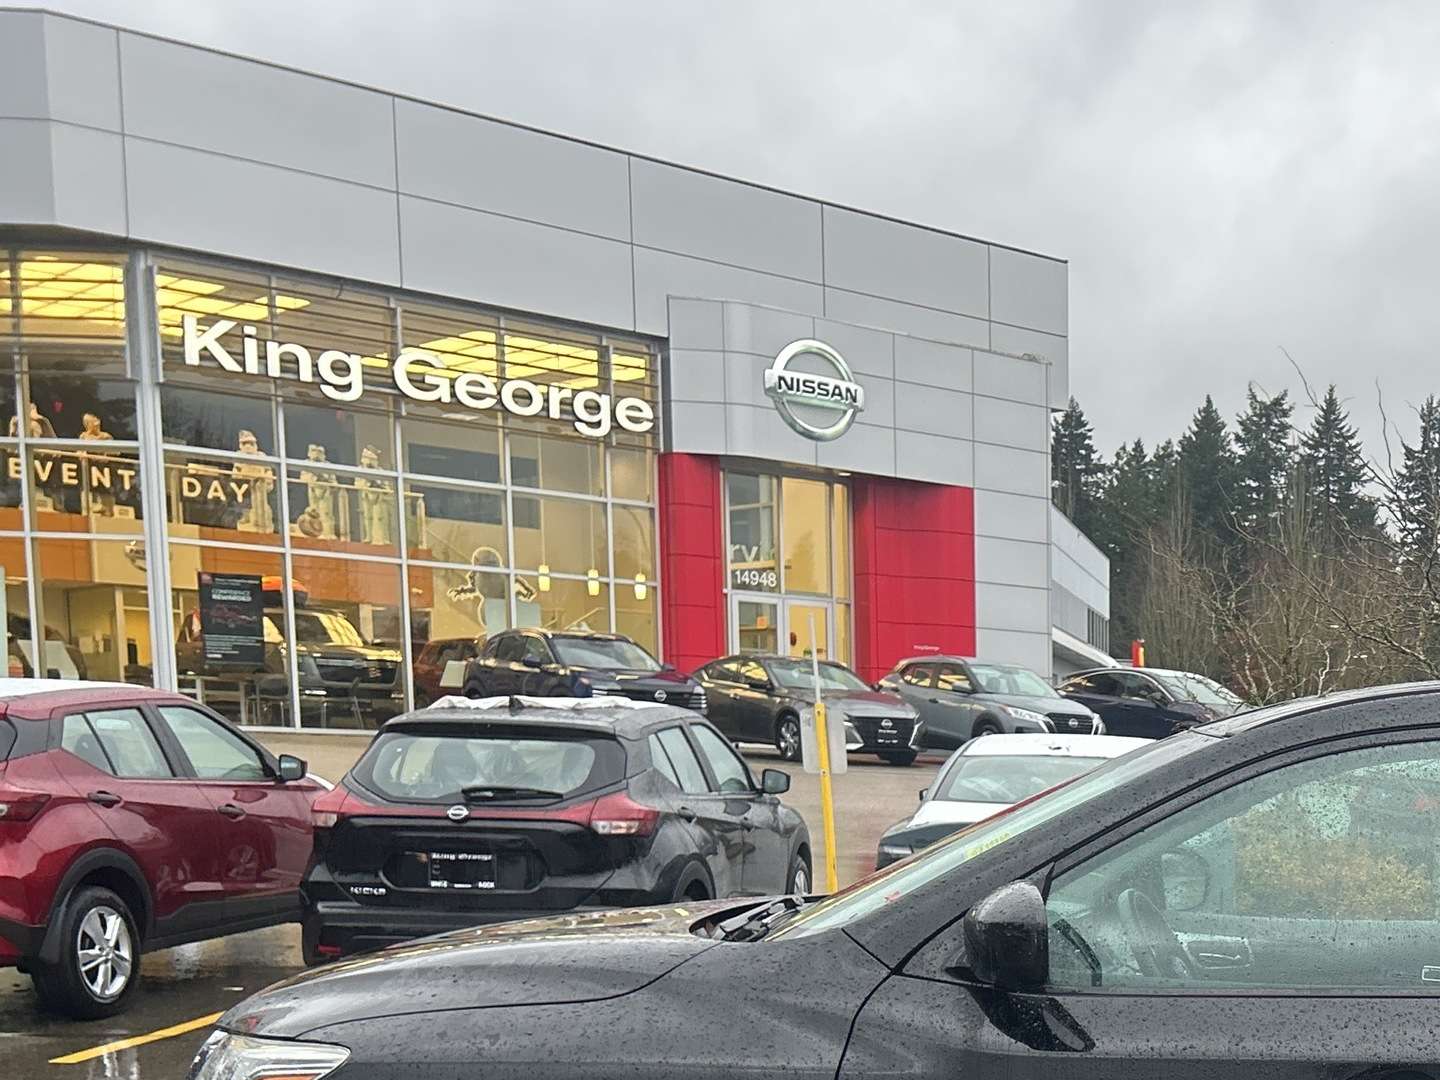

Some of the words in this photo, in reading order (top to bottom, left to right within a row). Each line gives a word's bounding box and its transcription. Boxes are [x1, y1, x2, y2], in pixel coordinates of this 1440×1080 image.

[181, 313, 364, 401] King
[392, 351, 655, 438] George
[777, 375, 858, 403] NISSAN
[8, 457, 136, 491] EVENT
[181, 476, 249, 503] DAY
[735, 569, 777, 588] 14948
